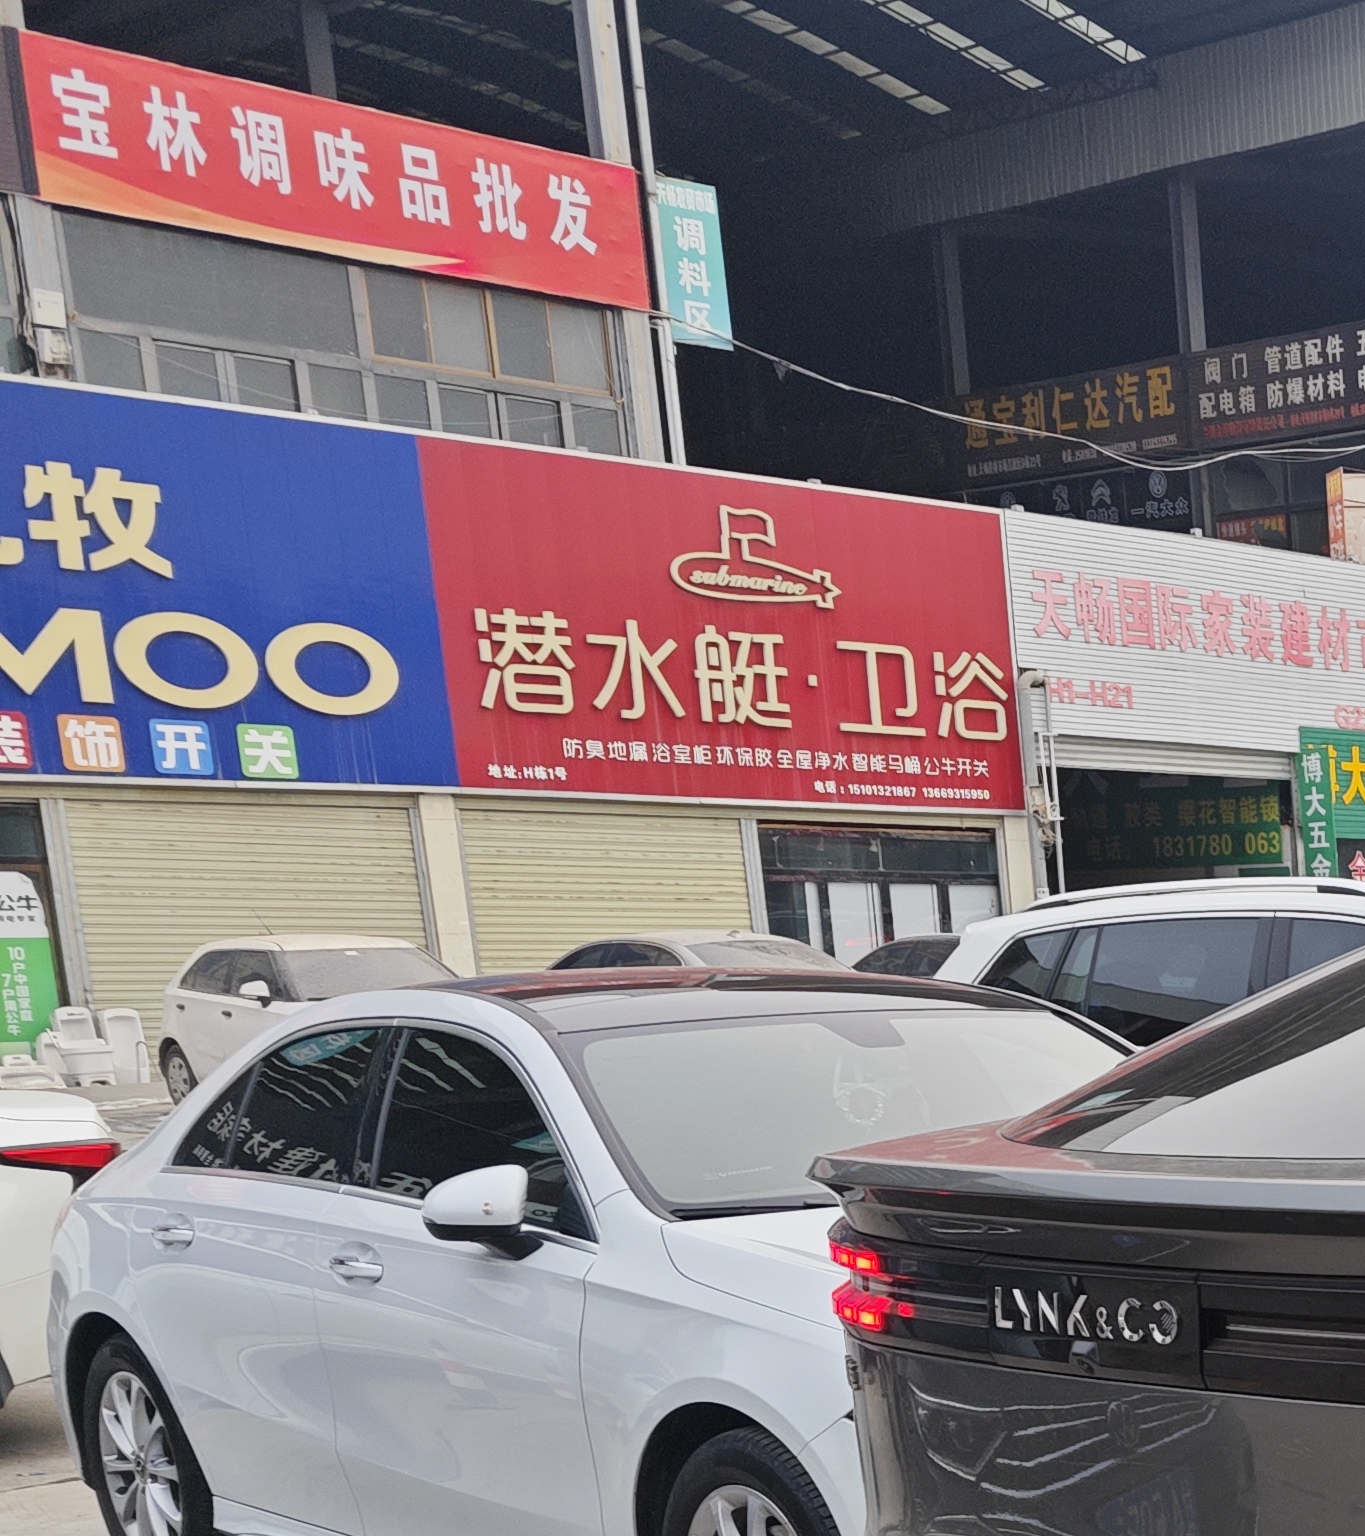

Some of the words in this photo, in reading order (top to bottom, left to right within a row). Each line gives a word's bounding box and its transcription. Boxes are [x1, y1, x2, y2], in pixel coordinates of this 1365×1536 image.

[50, 68, 599, 255] 宝林调味品批发
[673, 216, 712, 334] 调料区
[1199, 384, 1257, 419] 配电箱
[1266, 369, 1346, 409] 防爆材料
[1204, 353, 1248, 385] 阀门
[1264, 334, 1345, 374] 管道配件
[0, 461, 174, 579] 牧
[690, 565, 807, 597] submarine
[473, 607, 1009, 742] 潜水艇·卫浴
[562, 737, 649, 763] 防臭地漏
[651, 742, 713, 766] 浴室柜
[716, 745, 773, 768] 环保胶
[777, 749, 850, 771] 全屋净水
[852, 753, 922, 775] 智能马桶
[924, 757, 990, 778] 公牛开关
[1301, 752, 1332, 877] 博大五金
